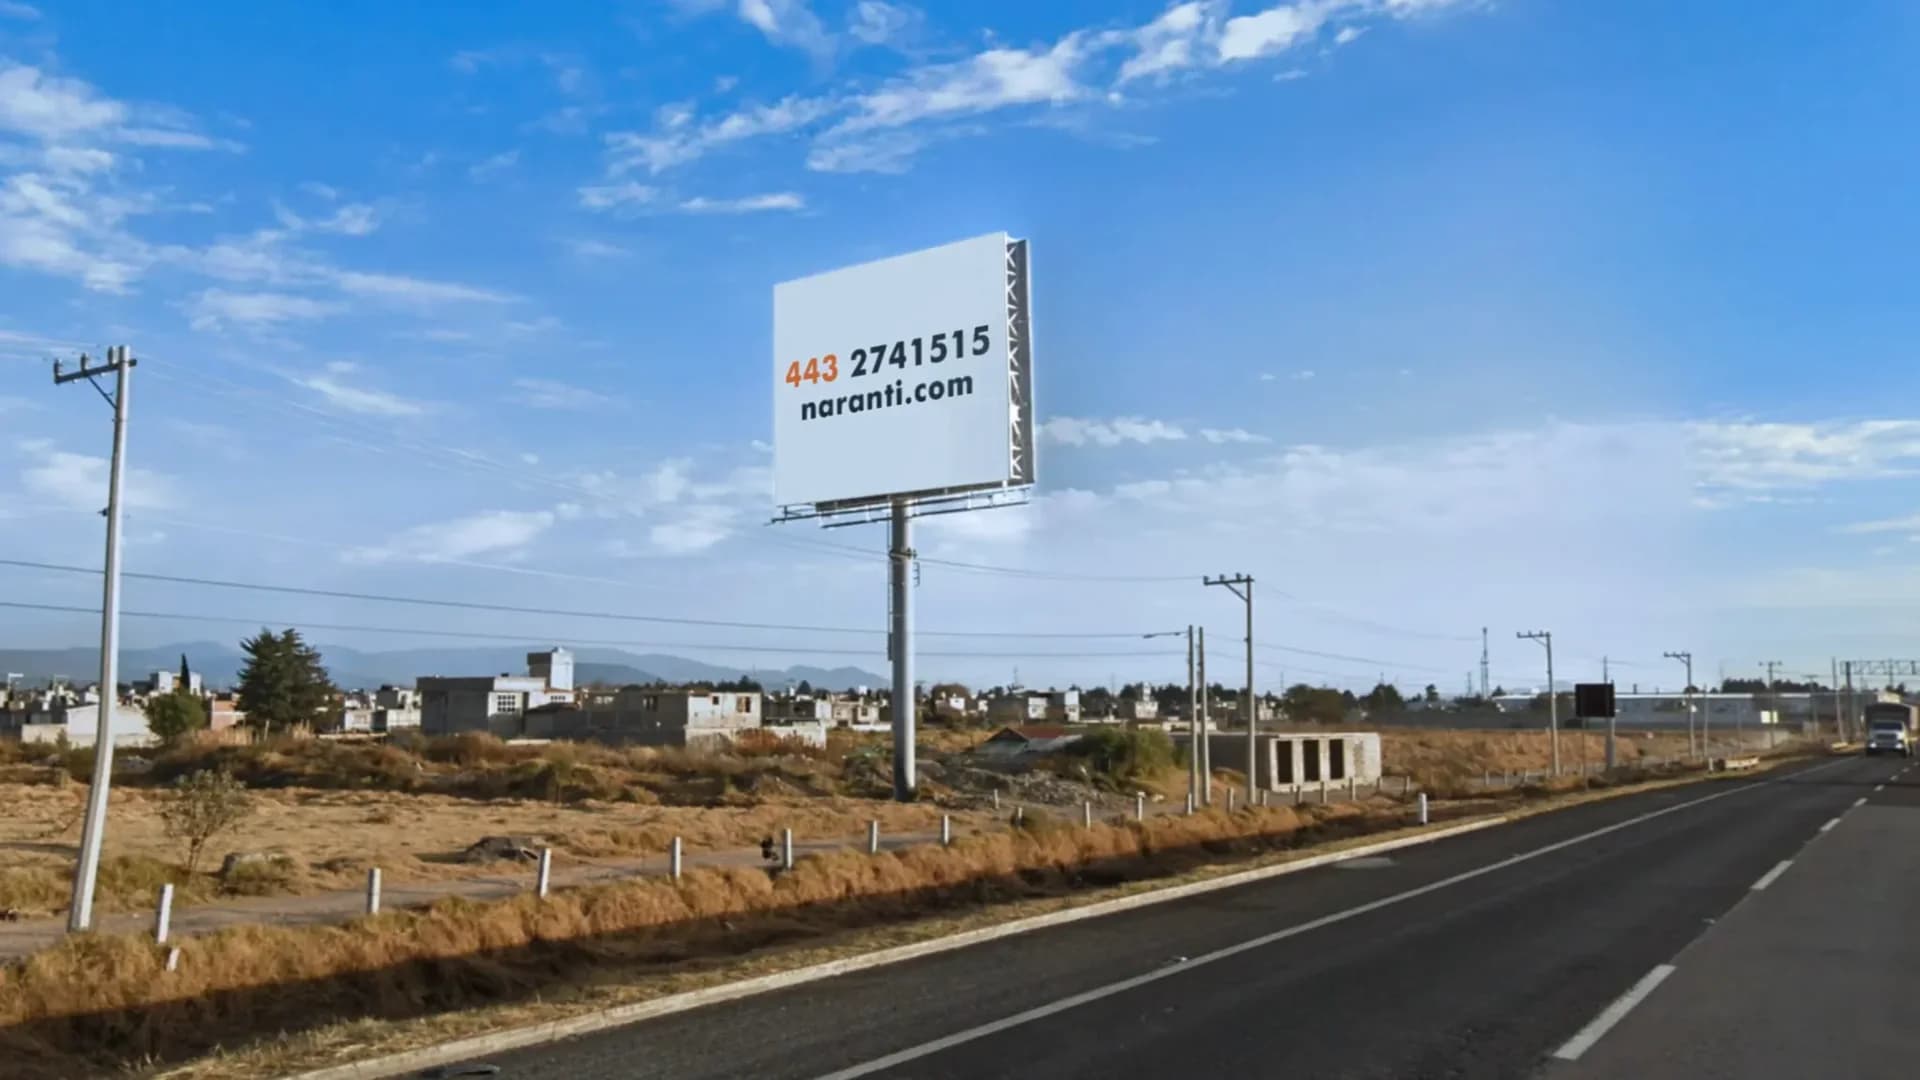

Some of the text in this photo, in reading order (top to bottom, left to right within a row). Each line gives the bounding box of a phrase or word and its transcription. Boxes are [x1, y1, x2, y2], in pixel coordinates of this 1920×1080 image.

[785, 324, 991, 388] 443 2741515
[801, 375, 974, 421] naranti.com
